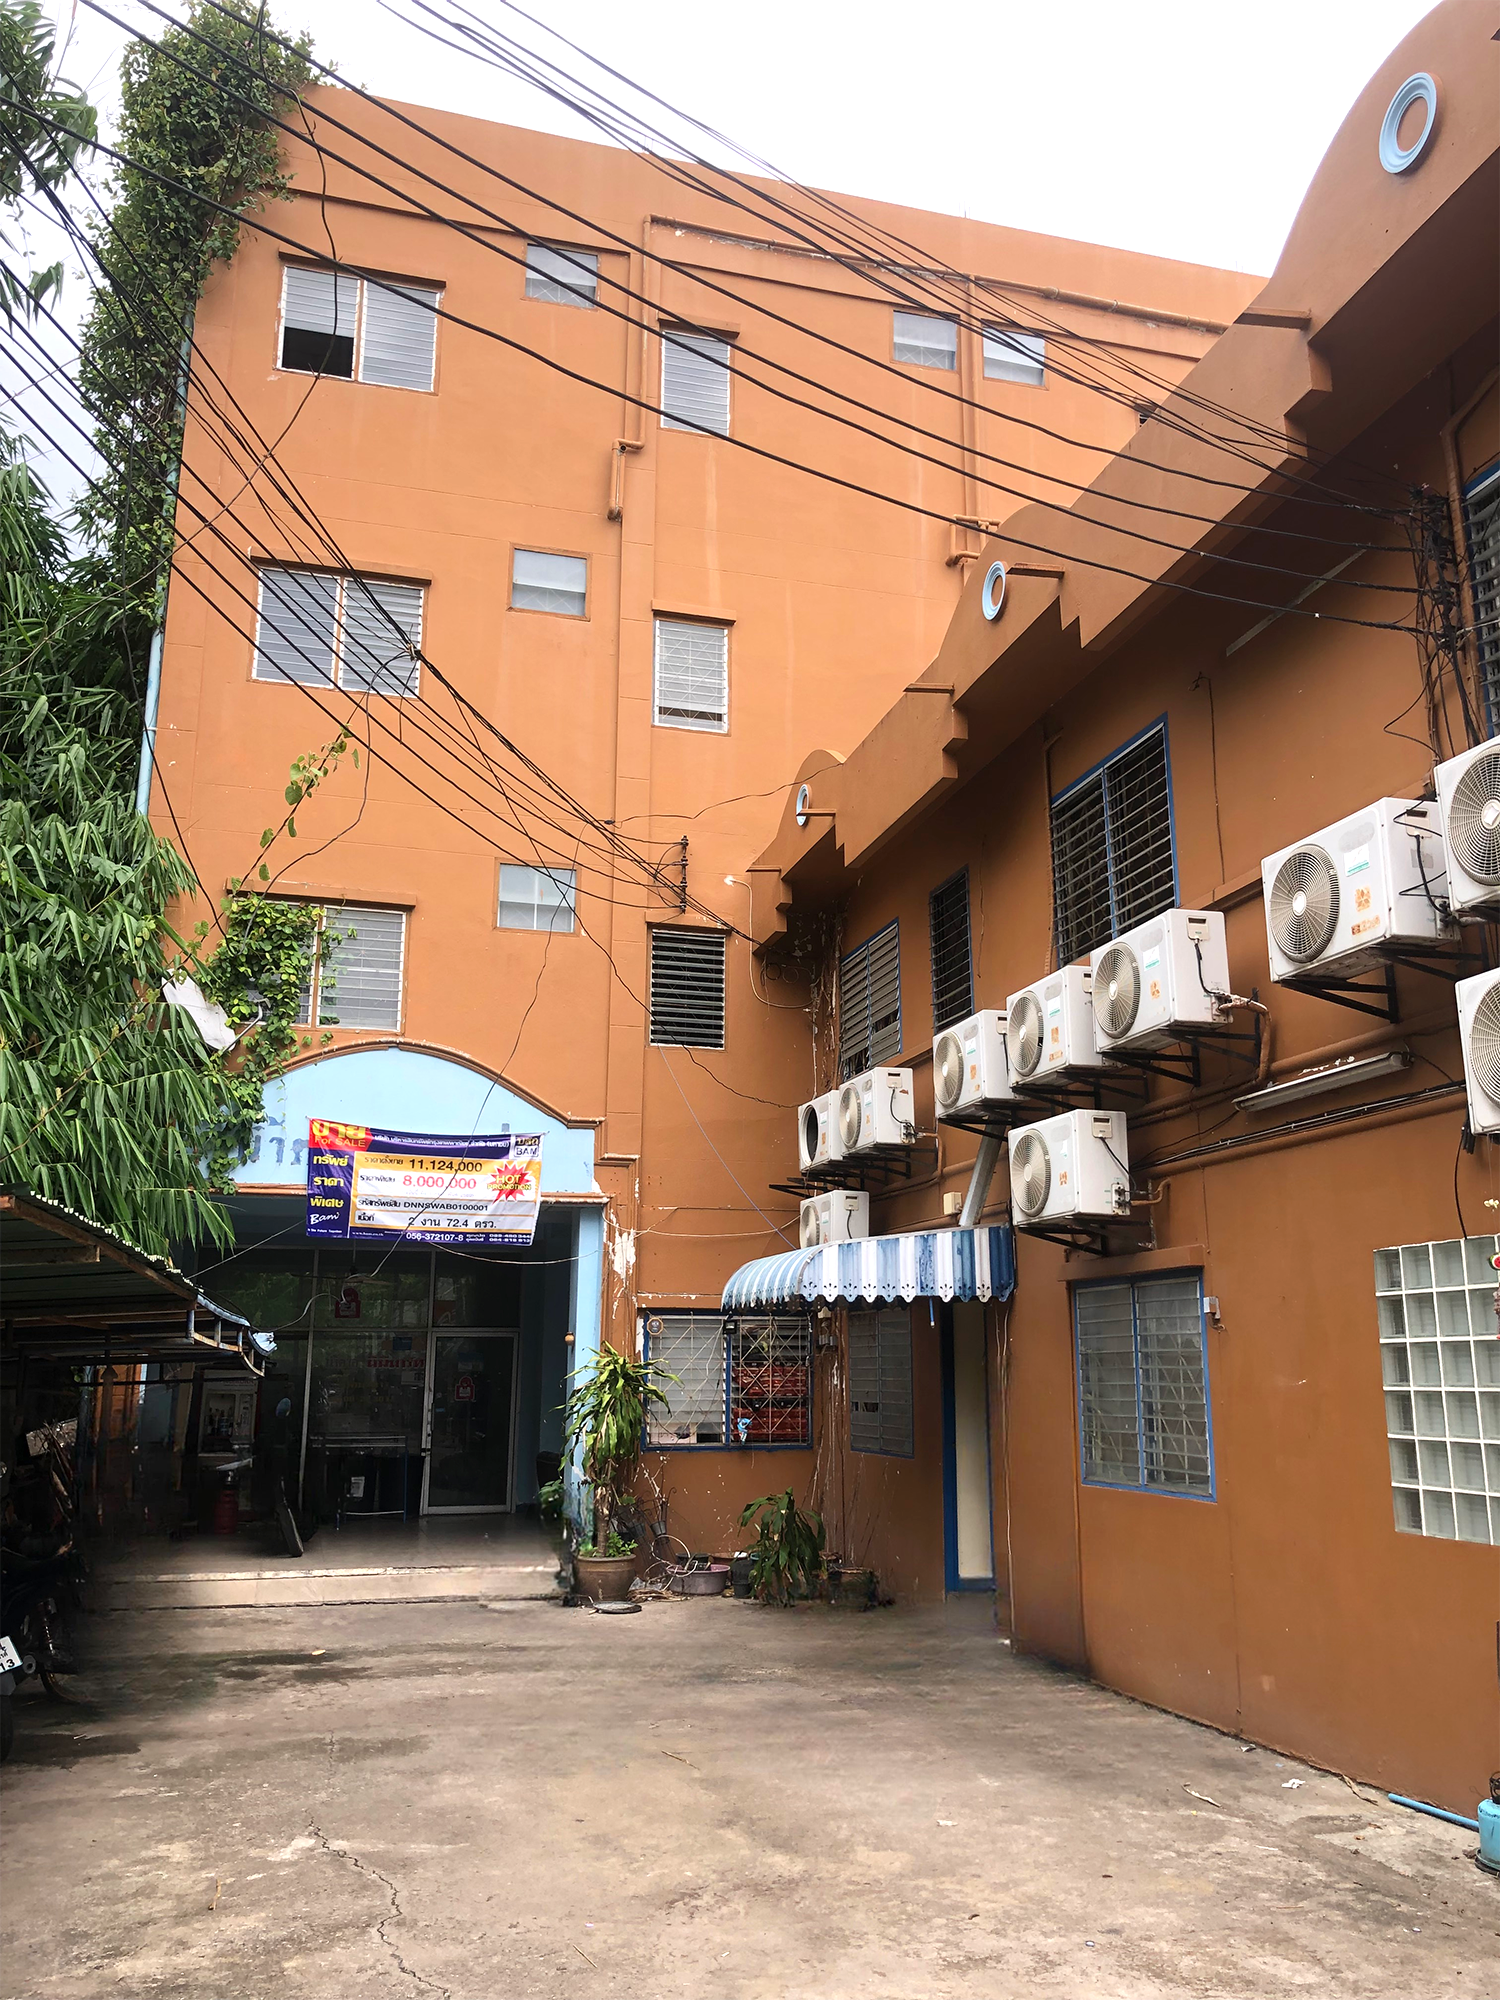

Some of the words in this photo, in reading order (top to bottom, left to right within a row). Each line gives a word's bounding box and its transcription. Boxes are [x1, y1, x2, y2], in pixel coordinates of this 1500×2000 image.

[312, 1120, 366, 1140] ขาย
[314, 1135, 332, 1145] For
[335, 1138, 366, 1148] SALE
[516, 1148, 538, 1156] BAM
[313, 1154, 349, 1166] ทรัพย์
[313, 1176, 345, 1187] ราคา
[495, 1174, 522, 1184] HOT
[487, 1183, 532, 1191] PROMOTION
[310, 1195, 344, 1208] พิเศษ
[403, 1201, 488, 1211] DNNSWAB0100001
[420, 1218, 441, 1227] งาน
[446, 1218, 469, 1228] 72.4
[406, 1232, 464, 1241] 056-372107-8
